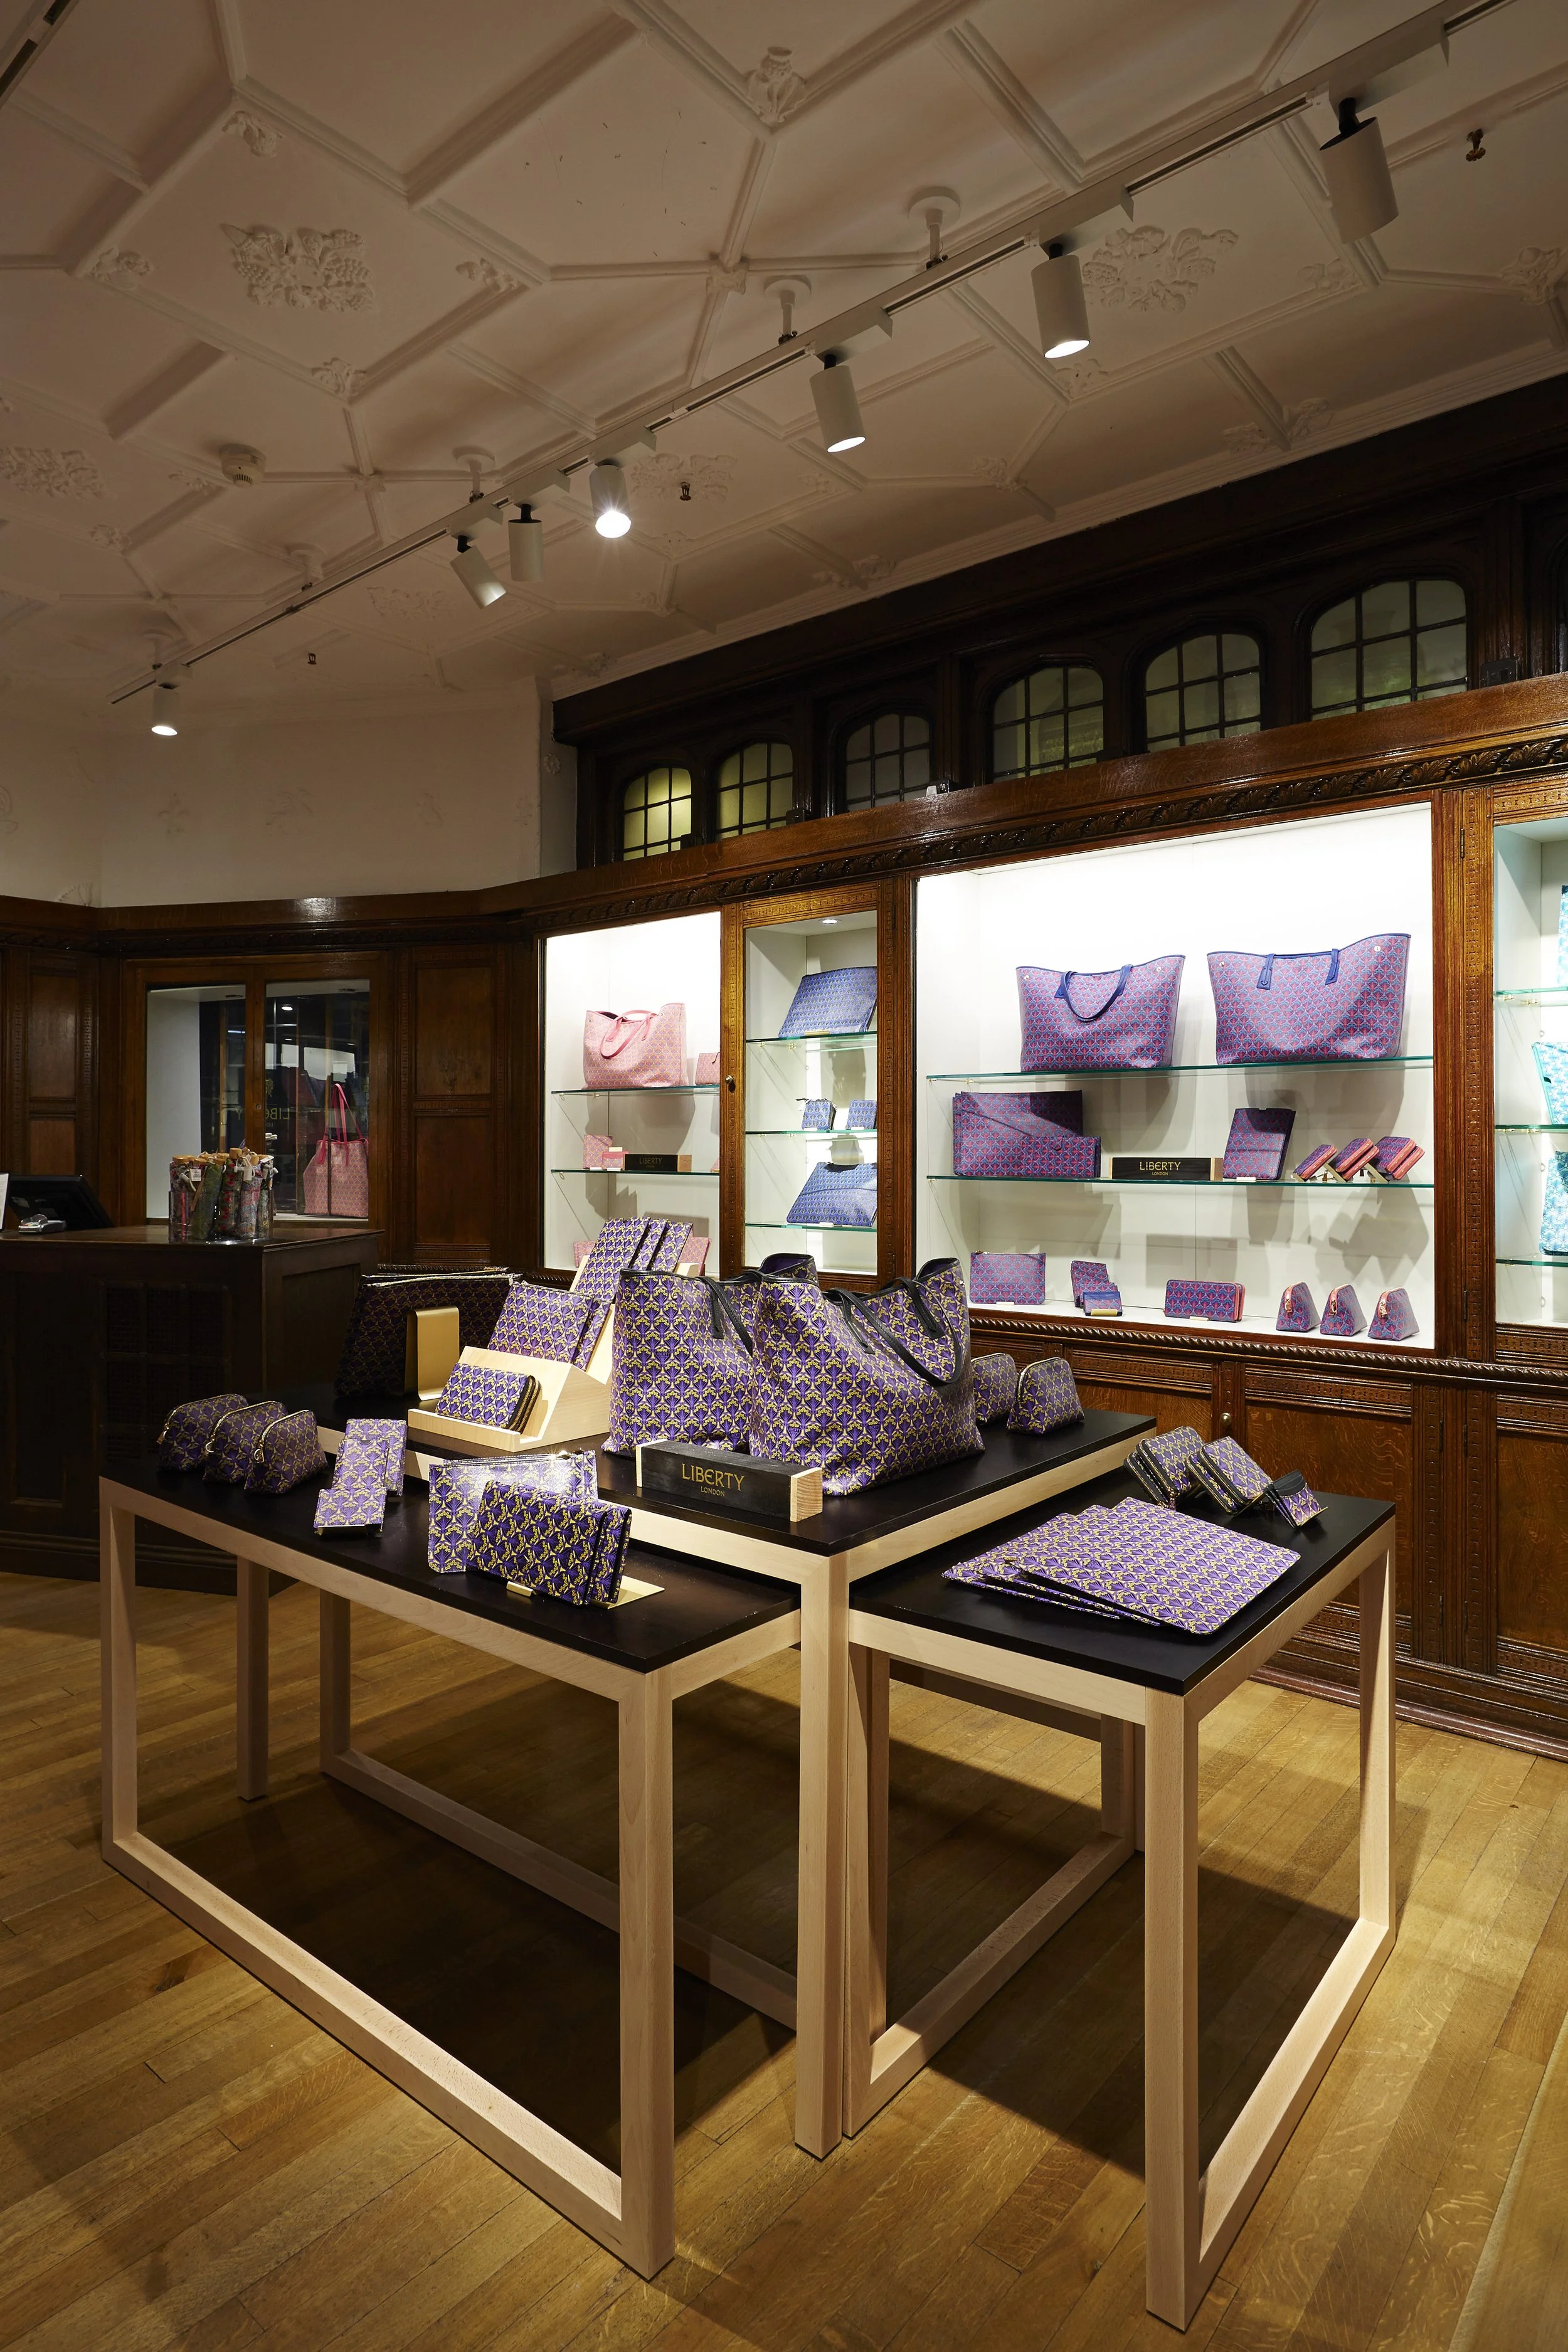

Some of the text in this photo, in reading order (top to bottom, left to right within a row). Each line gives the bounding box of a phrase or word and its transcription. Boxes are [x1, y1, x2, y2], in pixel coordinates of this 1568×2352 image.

[1140, 1162, 1181, 1170] LIBERTY
[682, 1463, 744, 1491] LIBERTY
[701, 1486, 725, 1496] LONDON
